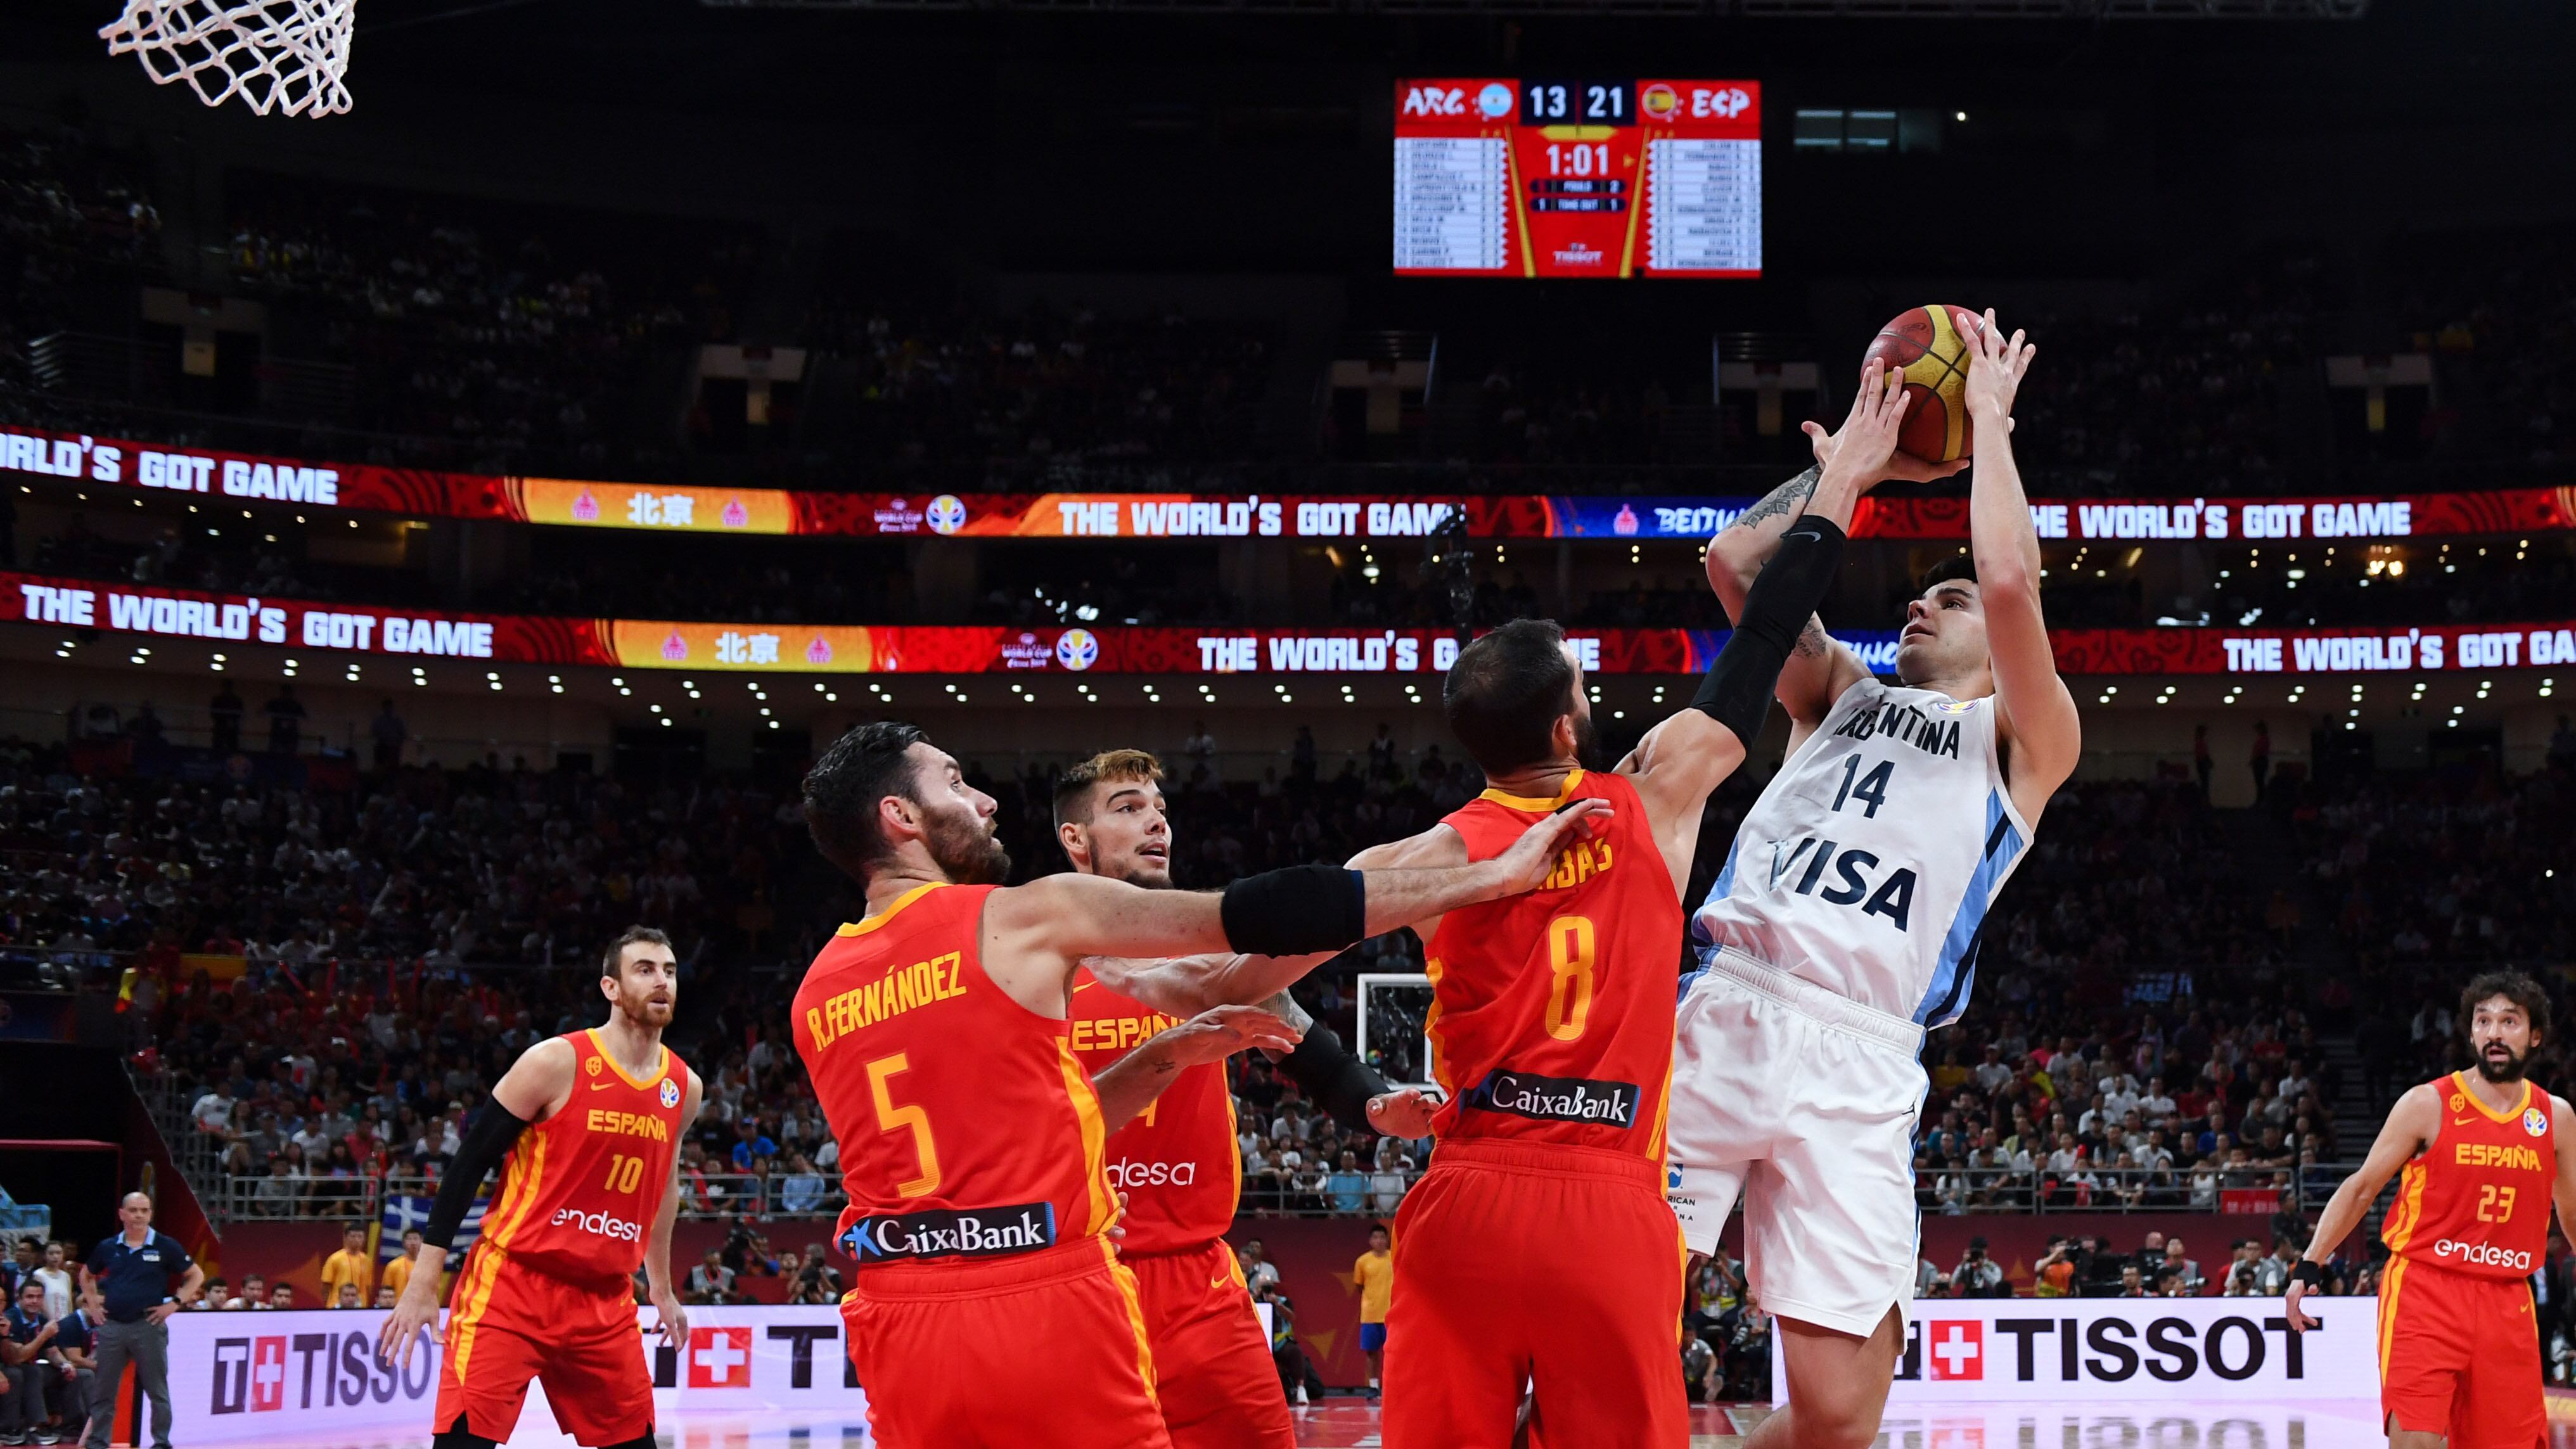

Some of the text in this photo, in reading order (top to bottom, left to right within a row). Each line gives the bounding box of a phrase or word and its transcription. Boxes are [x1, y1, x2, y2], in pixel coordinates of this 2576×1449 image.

[1404, 87, 1464, 115] ARG
[1530, 86, 1567, 117] 13
[1587, 86, 1622, 117] 21
[1691, 89, 1750, 117] ESP
[1546, 144, 1608, 176] 1:01
[139, 451, 215, 492] GOT
[223, 460, 338, 505] GAME
[627, 492, 695, 526] 北京
[1058, 495, 1454, 536] THE WORLD'S GOT GAM
[1653, 506, 1745, 534] BEIJI
[2028, 497, 2411, 539] HE WORLD'S GOT GAME
[21, 584, 493, 658] THE WORLD'S GOT GAME
[715, 632, 781, 664] 北京
[1197, 637, 1257, 671] THE
[1269, 630, 1419, 671] WORLD'S
[2222, 628, 2576, 672] THE WORLD'S GOT GA
[1833, 701, 1961, 760] RGNTINA
[1831, 753, 1895, 819] 14
[1536, 837, 1613, 890] IBAS
[1767, 838, 1918, 933] VISA
[1546, 916, 1596, 1042] 8
[806, 950, 968, 1052] R.FERNÁNDEZ
[1072, 1011, 1186, 1051] ESPAÑ
[1492, 1076, 1629, 1123] CaixaBank
[587, 1108, 668, 1143] ESPAÑA
[866, 1052, 942, 1199] 5
[604, 1154, 644, 1194] 10
[1106, 1156, 1196, 1188] desa
[2455, 1143, 2542, 1171] ESPAÑA
[1667, 1195, 1696, 1206] RICAN
[2477, 1184, 2516, 1223] 23
[876, 1211, 1046, 1254] CaixaBank
[2434, 1239, 2532, 1270] endesa
[1995, 1316, 2323, 1382] TISSOT
[293, 1331, 444, 1409] TISSO
